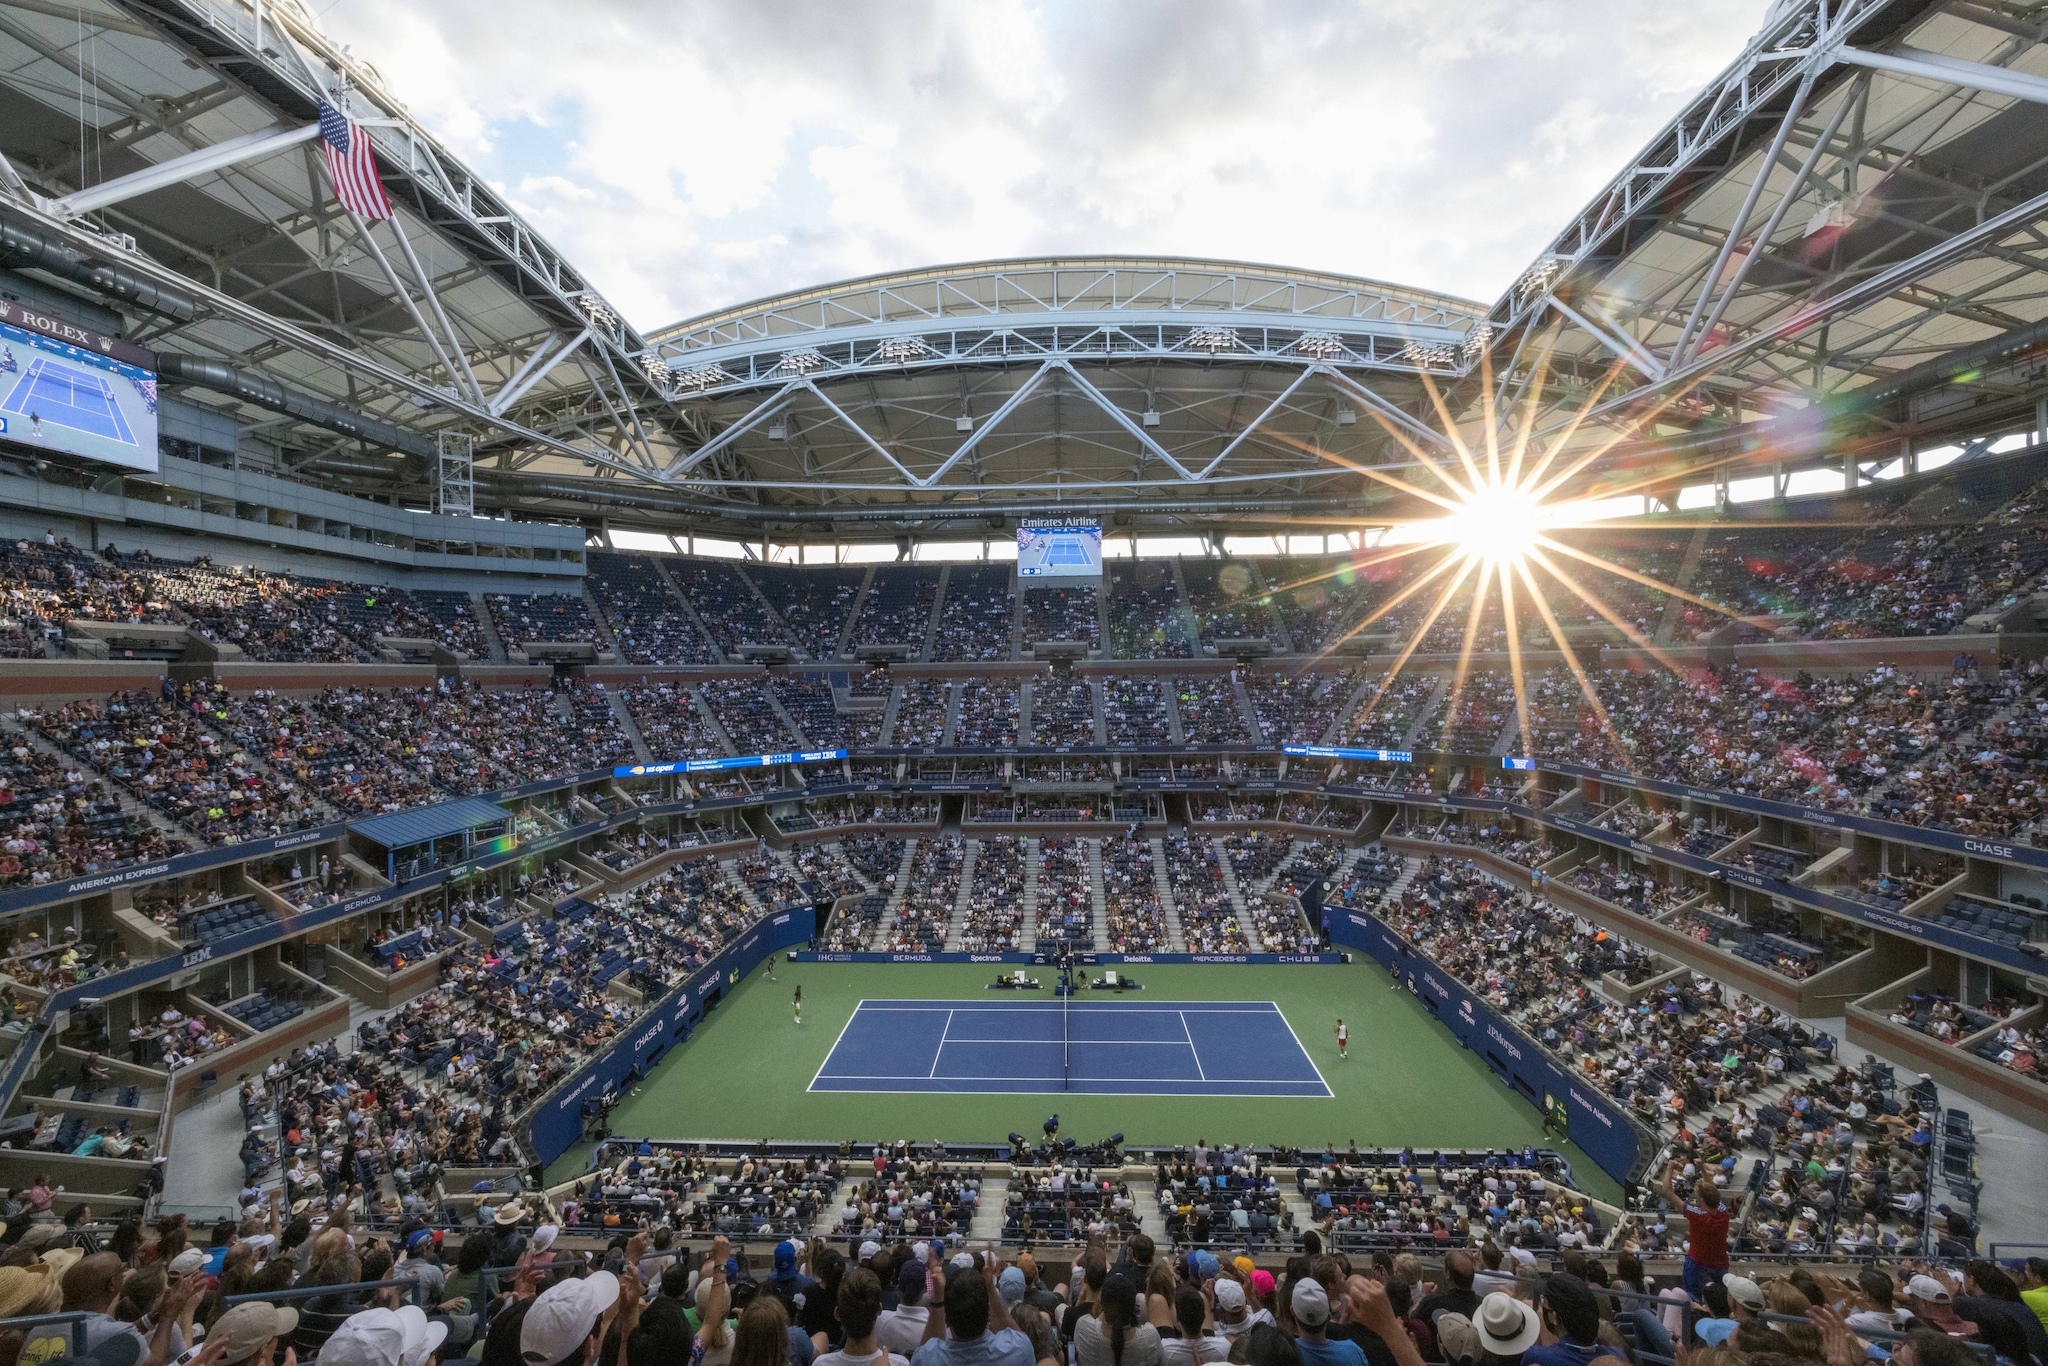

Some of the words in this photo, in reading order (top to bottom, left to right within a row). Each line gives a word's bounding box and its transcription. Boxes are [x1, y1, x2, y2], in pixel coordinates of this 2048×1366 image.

[22, 311, 90, 345] ROLEX
[1021, 518, 1062, 528] Emirates
[1065, 517, 1098, 527] Airline
[822, 751, 836, 759] IBM
[655, 765, 674, 773] open
[564, 776, 579, 784] CHASE
[744, 795, 764, 803] CHASE
[1687, 789, 1706, 799] Emirates
[1706, 793, 1720, 801] Airline
[1803, 810, 1835, 824] J.P.Morgan
[274, 837, 300, 848] Emirates
[301, 832, 321, 843] Airline
[1964, 840, 2013, 858] CHASE
[68, 874, 123, 893] AMERICAN
[125, 864, 169, 881] EXPRESS
[1727, 870, 1763, 885] CHUBB
[344, 895, 382, 912] BERMUDA
[182, 947, 212, 968] IBM
[970, 954, 1000, 963] Spectrum
[699, 976, 715, 995] CHASE
[634, 1025, 658, 1051] CHASE
[1486, 1024, 1521, 1060] J.P.Morgan
[560, 1087, 580, 1109] Emirates
[580, 1074, 596, 1091] Airline
[1570, 1087, 1592, 1112] Emirates
[1592, 1107, 1612, 1129] Airline
